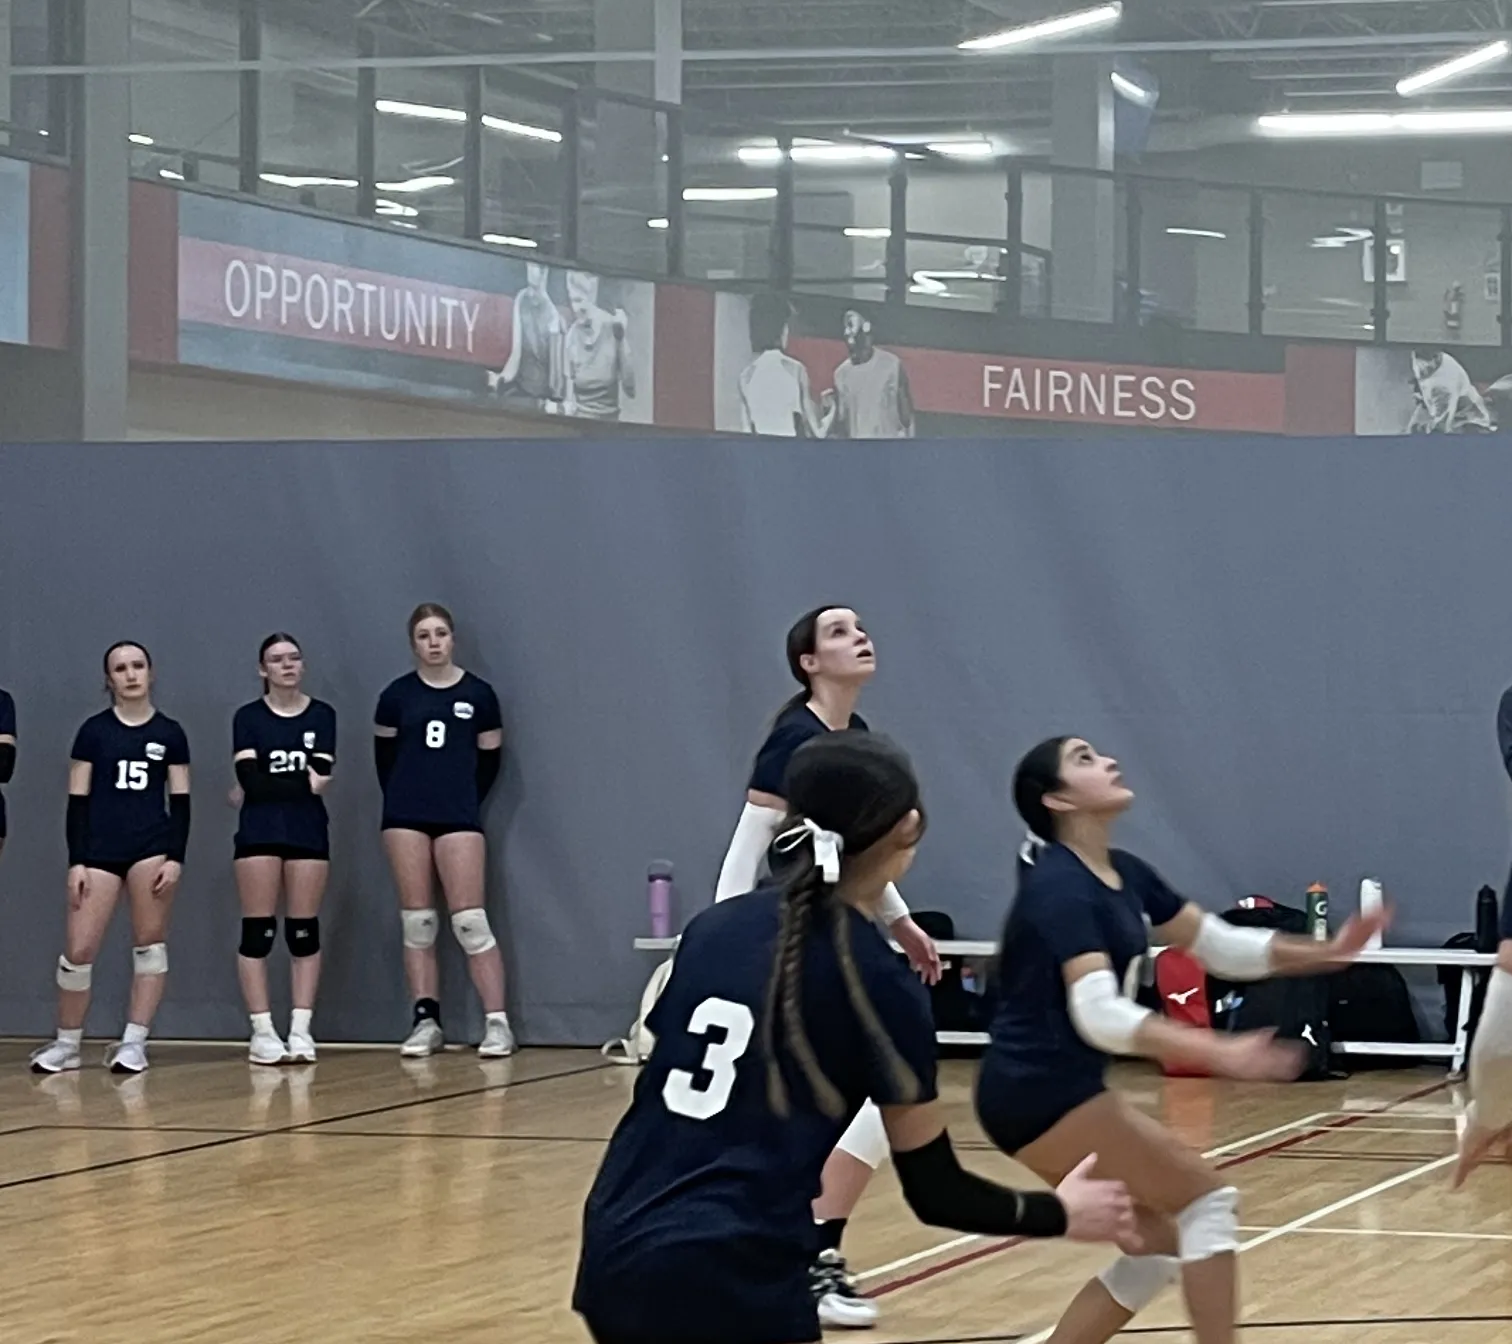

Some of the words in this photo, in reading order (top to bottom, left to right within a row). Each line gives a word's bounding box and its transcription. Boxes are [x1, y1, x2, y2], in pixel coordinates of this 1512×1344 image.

[224, 259, 480, 353] OPPORTUNITY
[983, 364, 1197, 421] FAIRNESS
[426, 719, 446, 748] 8
[115, 759, 149, 790] 15
[661, 996, 755, 1120] 3
